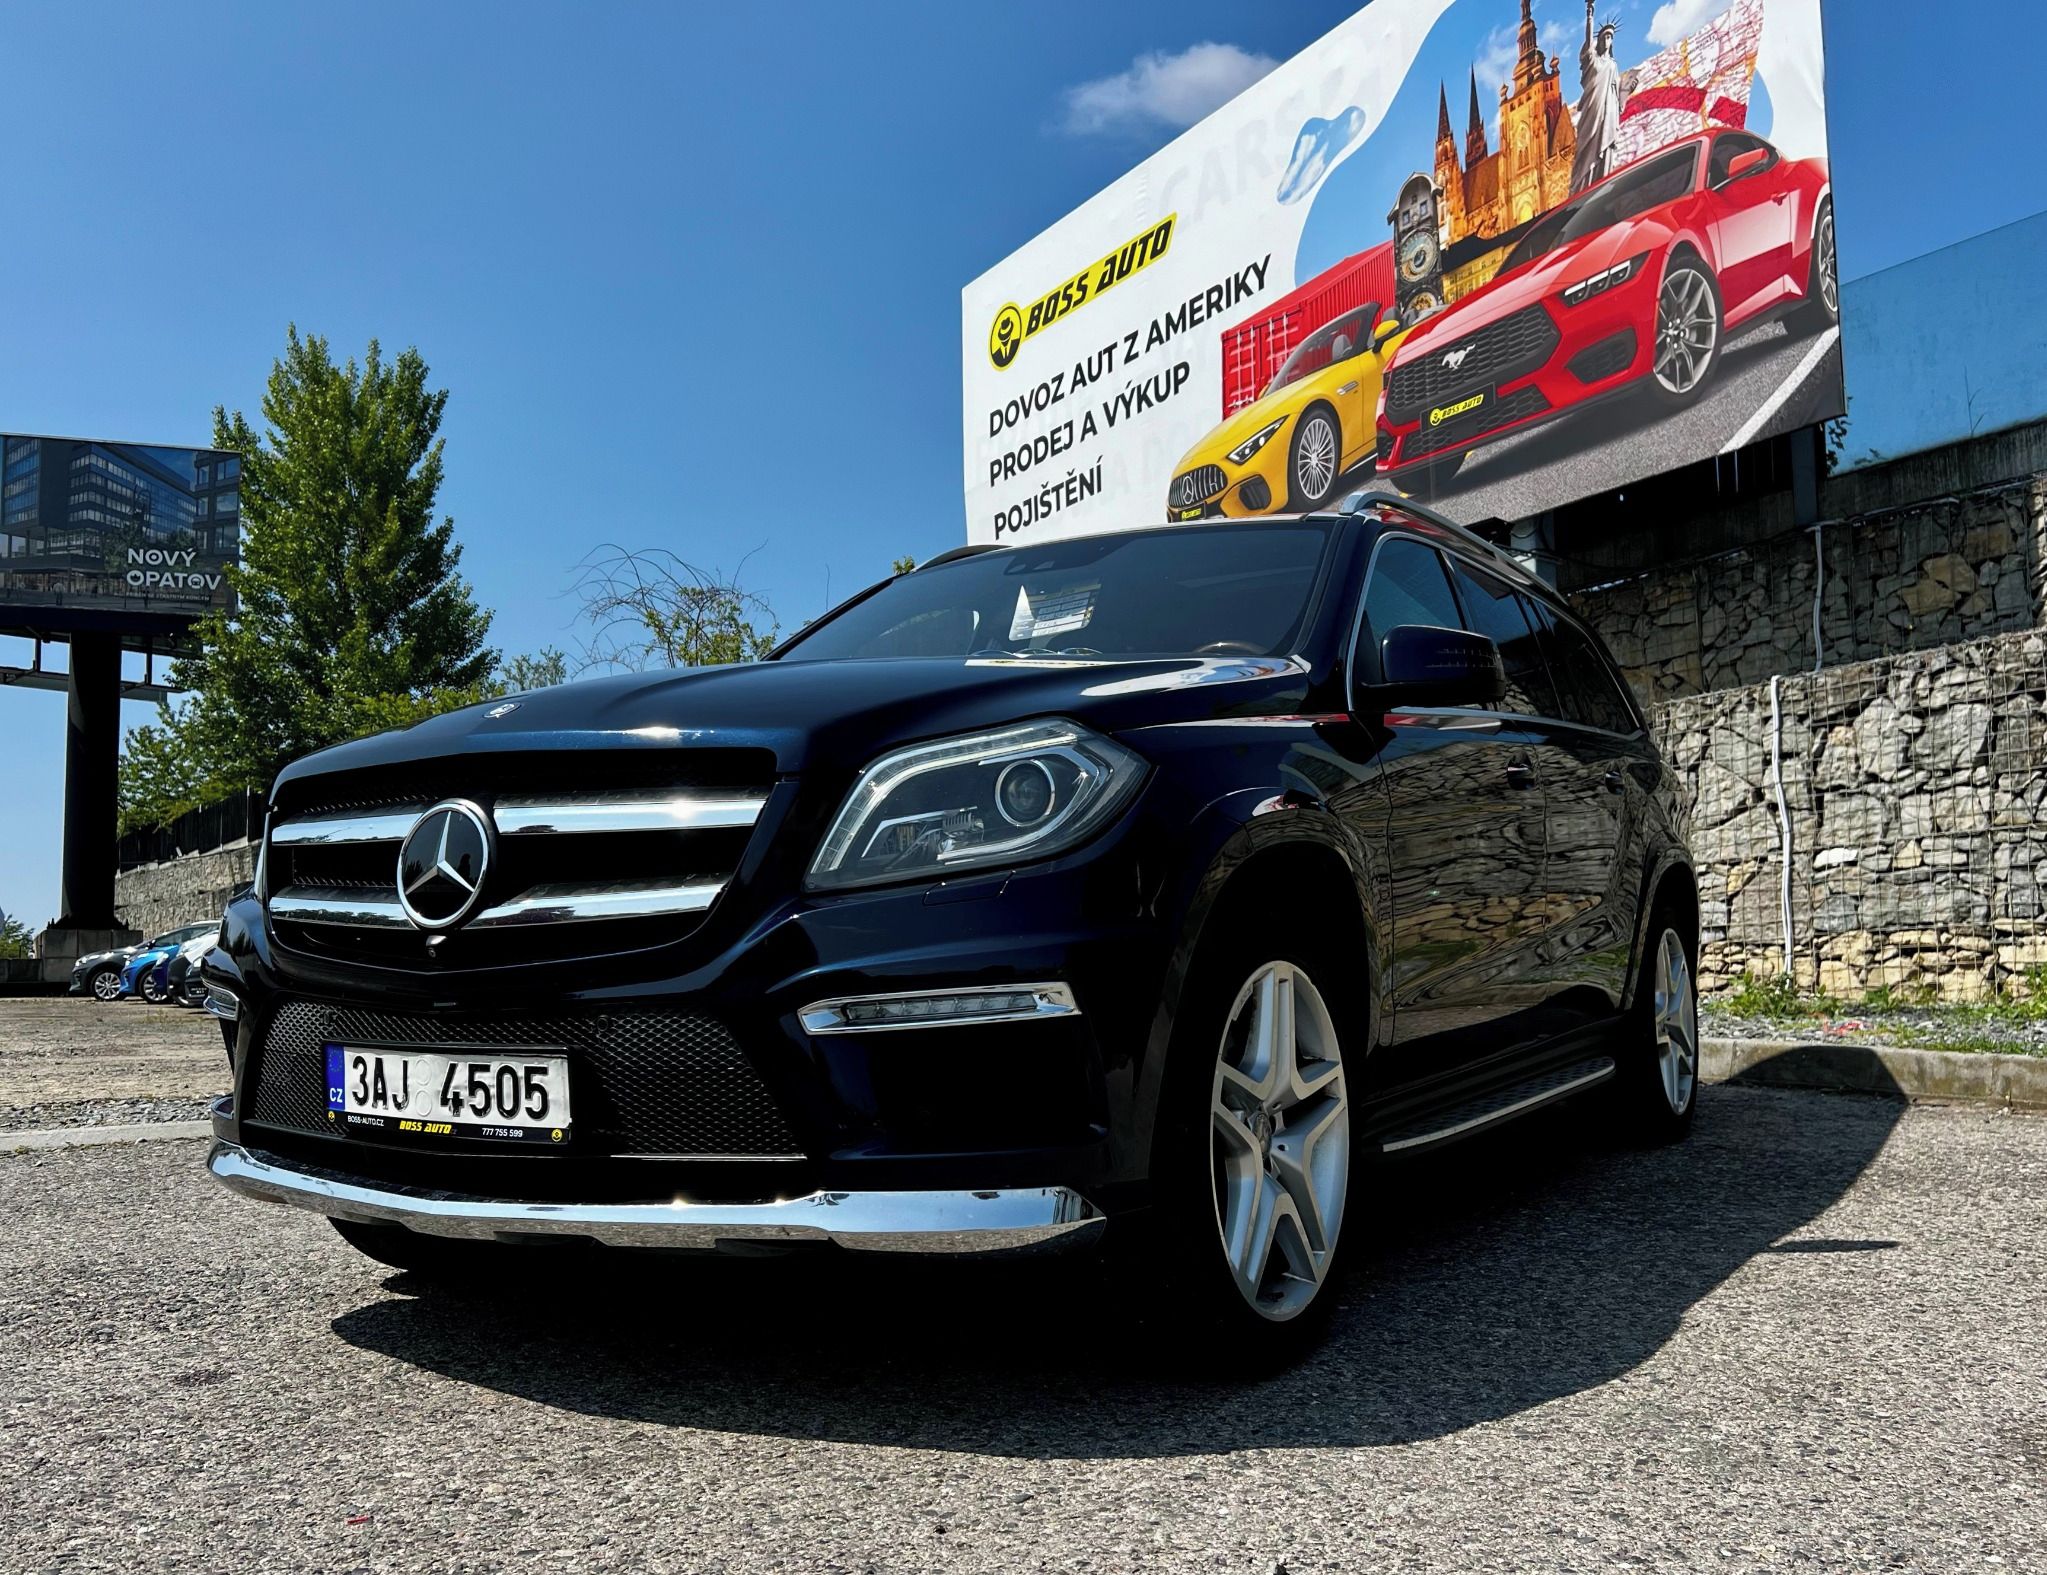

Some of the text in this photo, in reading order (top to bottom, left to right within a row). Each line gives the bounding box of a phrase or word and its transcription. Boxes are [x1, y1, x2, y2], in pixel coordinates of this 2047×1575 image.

[1025, 219, 1173, 337] BOSS AUTO
[989, 253, 1272, 438] DOVOZ AUT Z AMERIKY
[1442, 396, 1482, 417] BOSS AUTO
[989, 360, 1191, 488] PRODEJ A VÝKUP
[994, 454, 1104, 541] POJIŠTĚNÍ
[127, 547, 197, 568] NOVÝ
[126, 570, 221, 590] OPATOV
[329, 1087, 343, 1103] CZ
[352, 1055, 549, 1122] 3AJ 4505
[399, 1120, 423, 1132] BOSS
[424, 1123, 452, 1134] AUTO
[482, 1127, 523, 1138] 777 755 599
